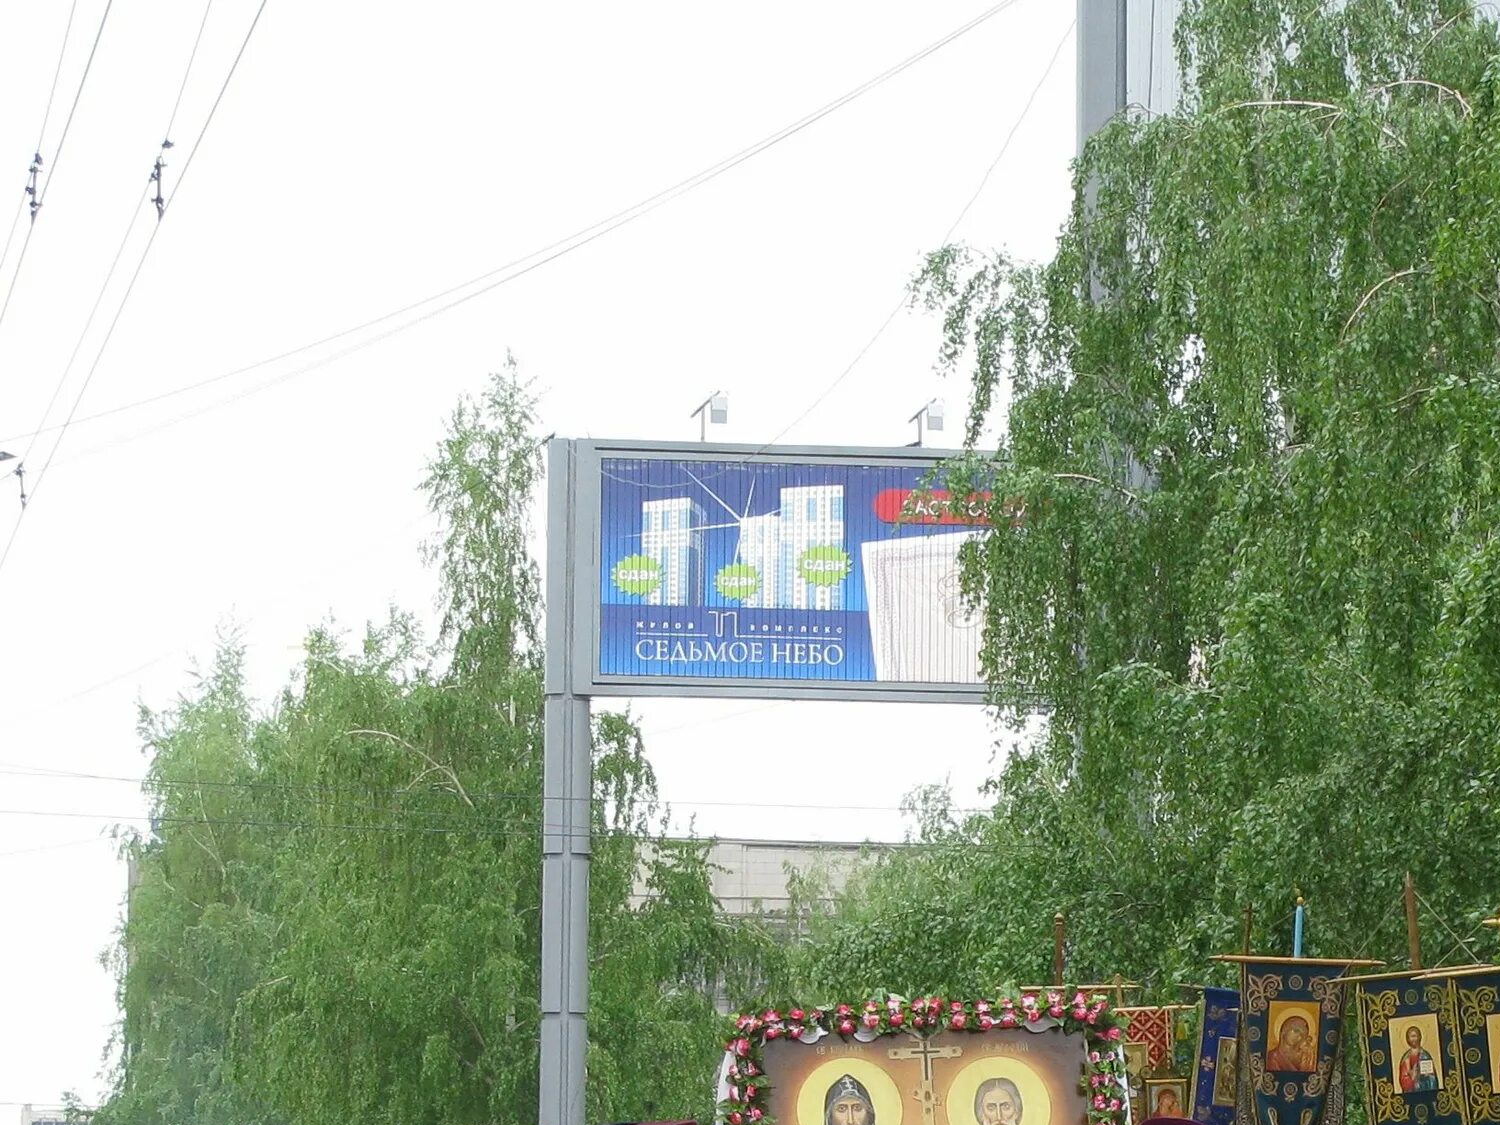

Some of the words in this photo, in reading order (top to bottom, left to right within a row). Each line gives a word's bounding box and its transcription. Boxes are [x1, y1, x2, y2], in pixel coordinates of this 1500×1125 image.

[803, 559, 846, 573] сдан
[618, 569, 659, 582] сдан
[720, 576, 756, 588] сдан
[750, 624, 843, 634] КОМПЛЕКС
[635, 639, 765, 665] СЕДЬМОЕ
[771, 642, 844, 666] НЕБО
